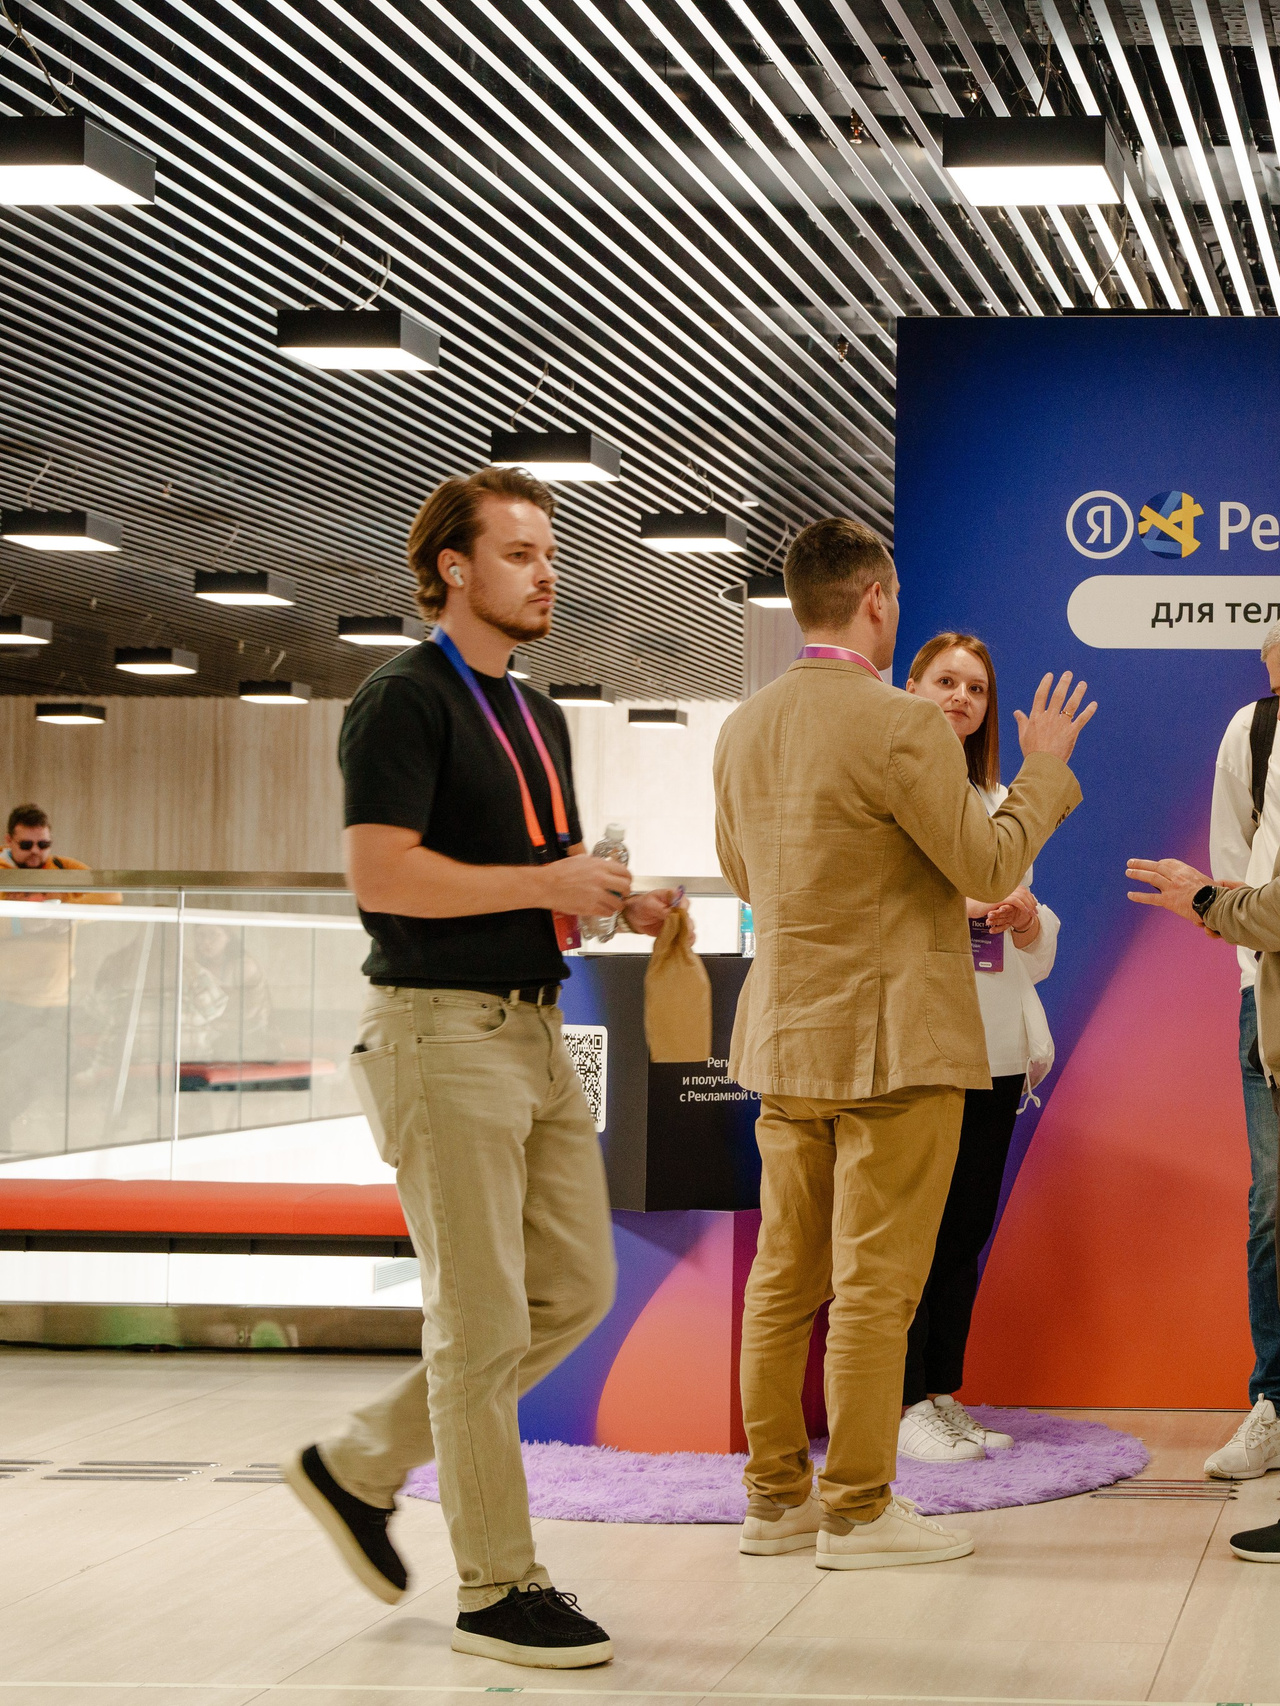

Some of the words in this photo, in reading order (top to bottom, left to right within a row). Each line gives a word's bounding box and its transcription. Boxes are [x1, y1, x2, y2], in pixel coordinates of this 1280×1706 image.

[1151, 602, 1214, 628] для
[682, 1077, 690, 1085] и
[680, 1093, 686, 1102] с
[688, 1090, 748, 1102] Рекламной
